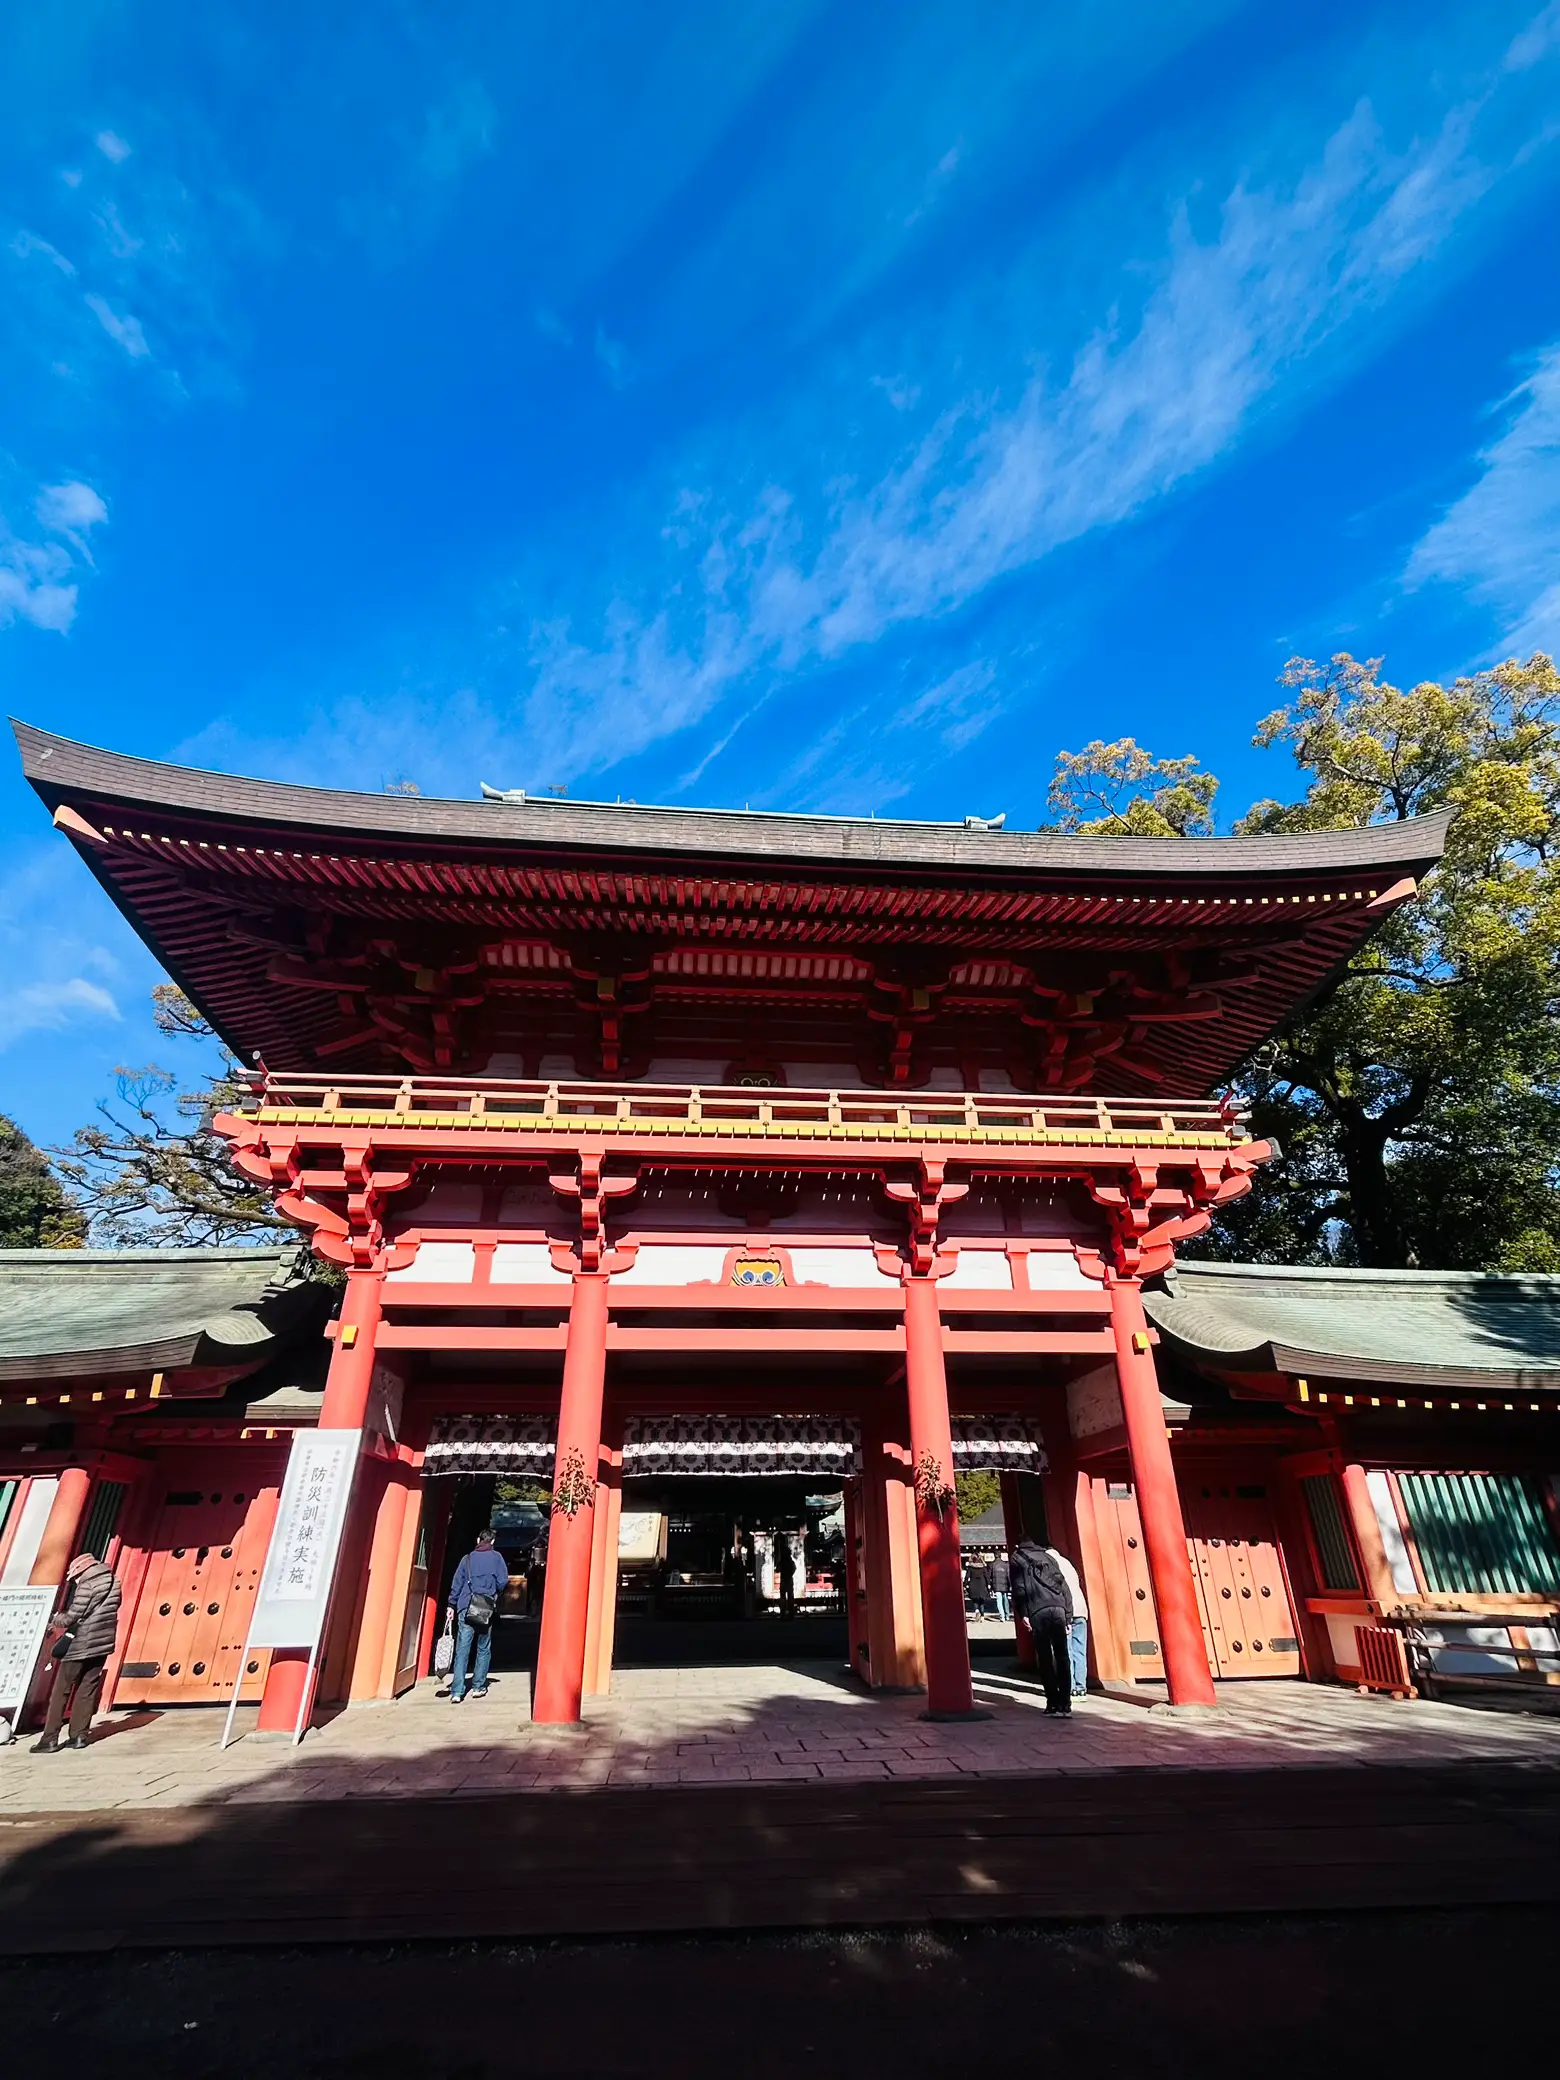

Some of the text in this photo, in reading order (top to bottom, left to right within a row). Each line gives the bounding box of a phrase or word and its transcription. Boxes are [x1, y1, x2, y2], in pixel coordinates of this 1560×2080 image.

[288, 1466, 328, 1584] 防災訓練実施
